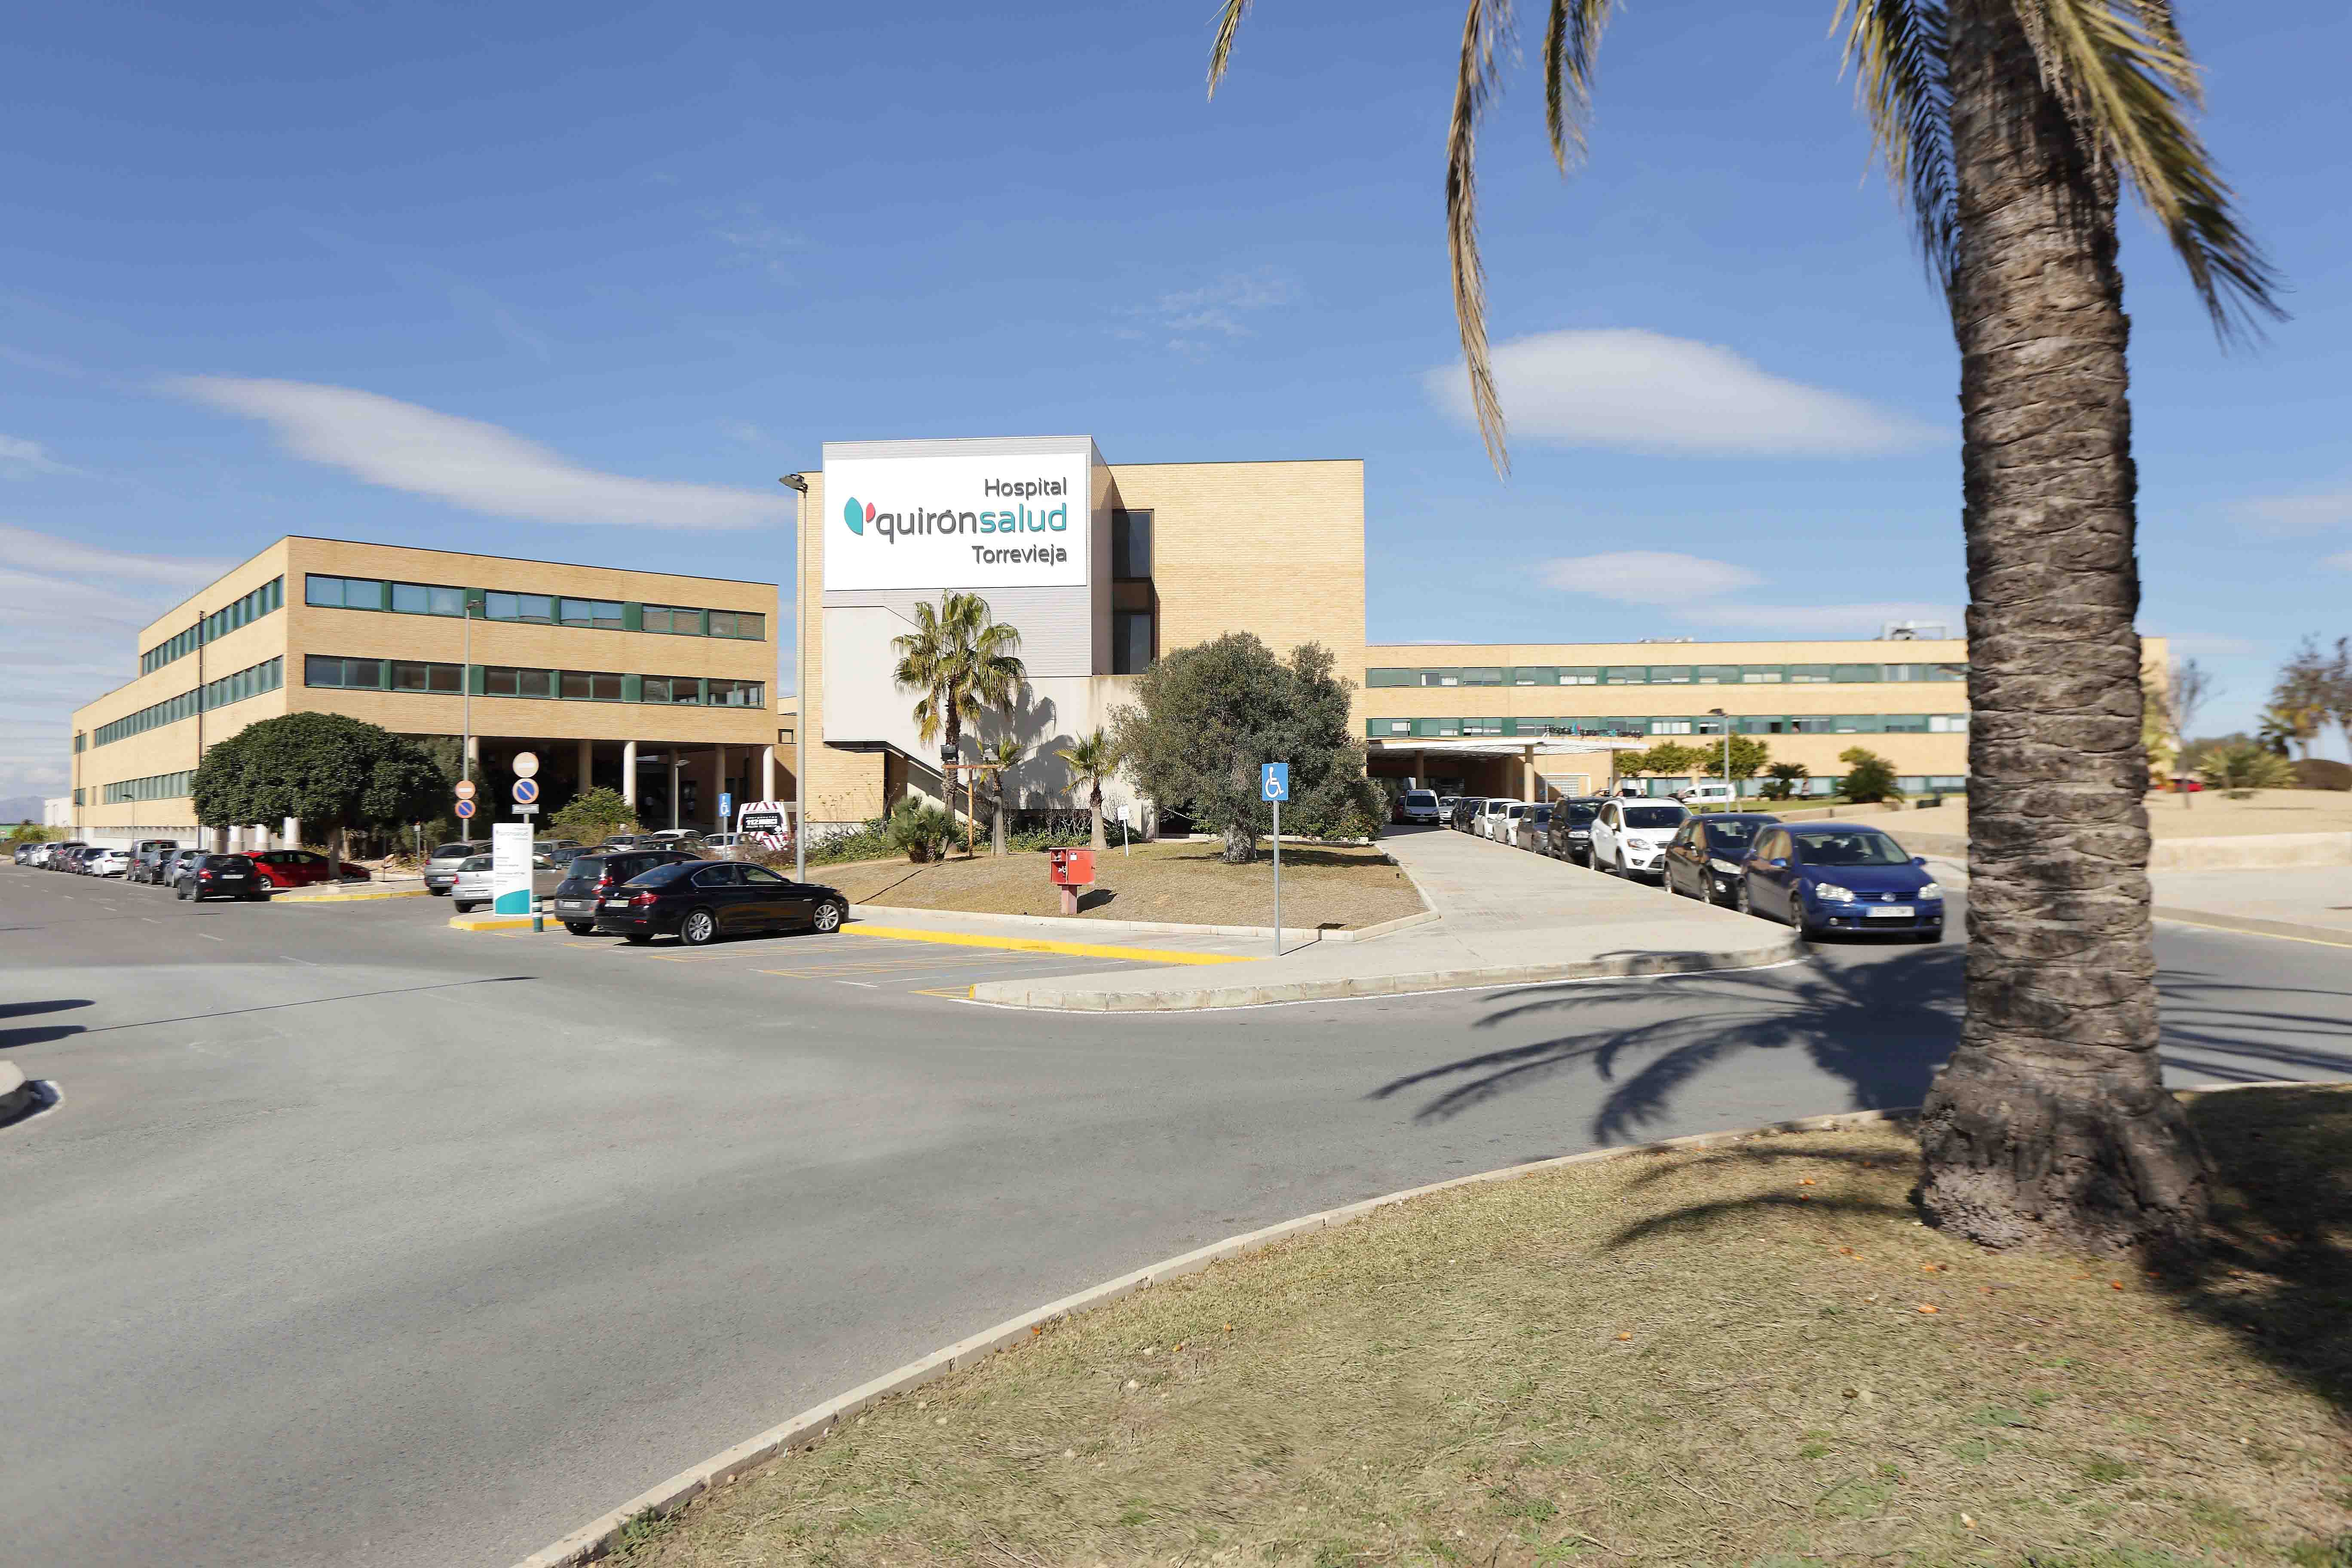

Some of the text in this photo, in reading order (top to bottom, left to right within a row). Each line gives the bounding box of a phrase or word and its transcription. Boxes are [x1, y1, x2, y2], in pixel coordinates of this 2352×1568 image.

[985, 477, 1066, 500] Hospital
[876, 502, 1066, 544] quirónsalud
[971, 544, 1067, 566] Torrevieja
